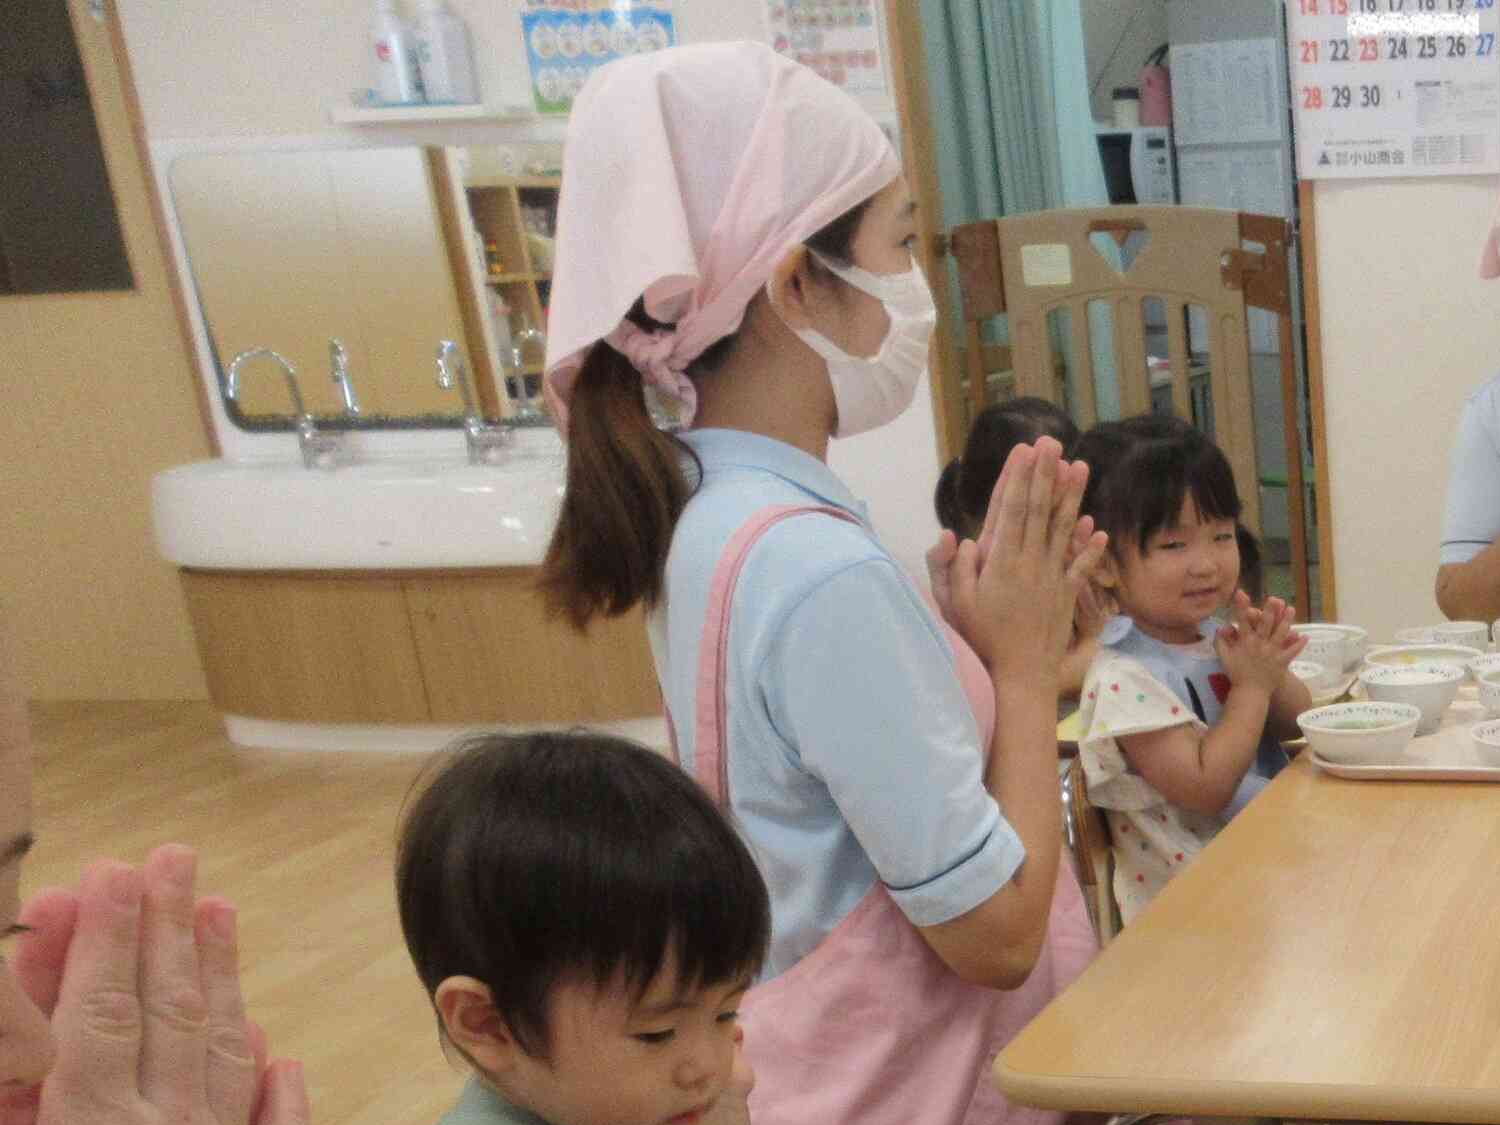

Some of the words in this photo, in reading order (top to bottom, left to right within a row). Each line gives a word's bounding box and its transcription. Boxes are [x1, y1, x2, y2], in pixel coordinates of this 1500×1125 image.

[1300, 41, 1318, 62] 21
[1329, 40, 1349, 61] 22
[1360, 39, 1377, 60] 23
[1388, 38, 1407, 59] 24
[1417, 37, 1437, 58] 25
[1447, 36, 1466, 56] 26
[1476, 34, 1494, 56] 27
[1303, 87, 1322, 109] 28
[1332, 86, 1351, 108] 29
[1360, 85, 1380, 107] 30
